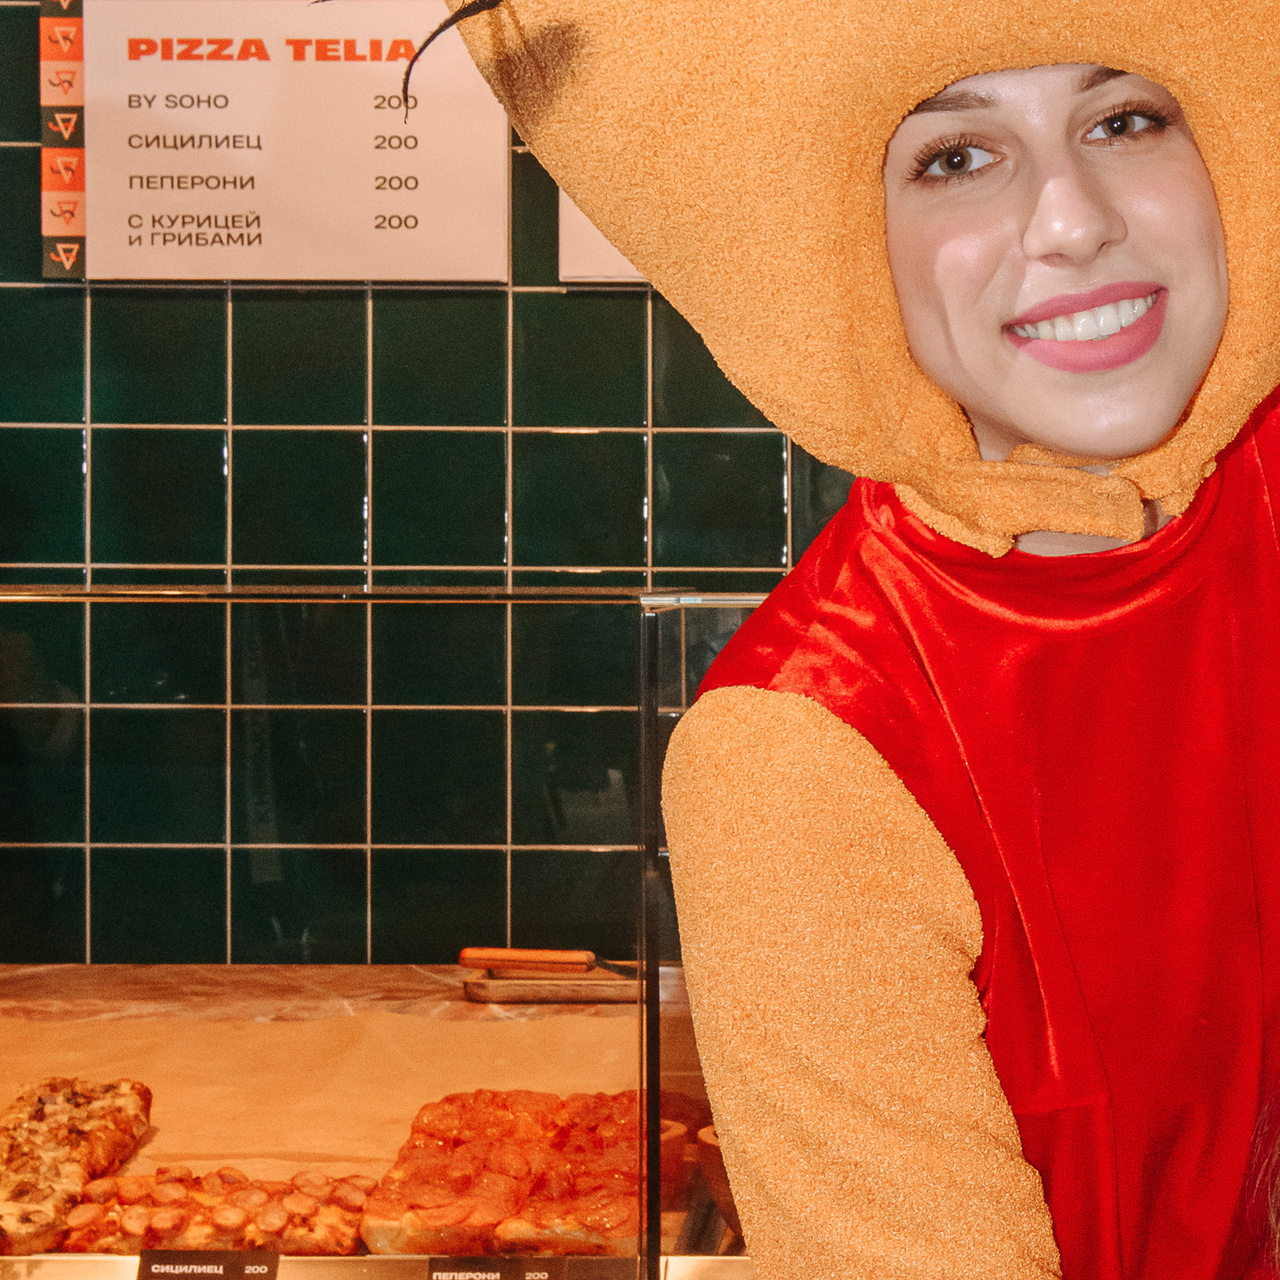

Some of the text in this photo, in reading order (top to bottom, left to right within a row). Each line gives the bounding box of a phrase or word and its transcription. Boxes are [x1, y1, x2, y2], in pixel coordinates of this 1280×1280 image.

[127, 38, 421, 62] PIZZA TELIA
[128, 94, 419, 110] BY SOHO 200
[128, 134, 419, 151] СИЦИЛИЕЦ 200
[128, 175, 419, 191] ПЕПЕРОНИ 200
[128, 210, 419, 231] С КУРИЦЕЙ 200
[151, 231, 263, 247] ГРИБАМИ
[151, 1264, 268, 1275] СИЦИЛИЕЦ 200
[432, 1271, 549, 1280] ПЕПЕРОНИ 200
